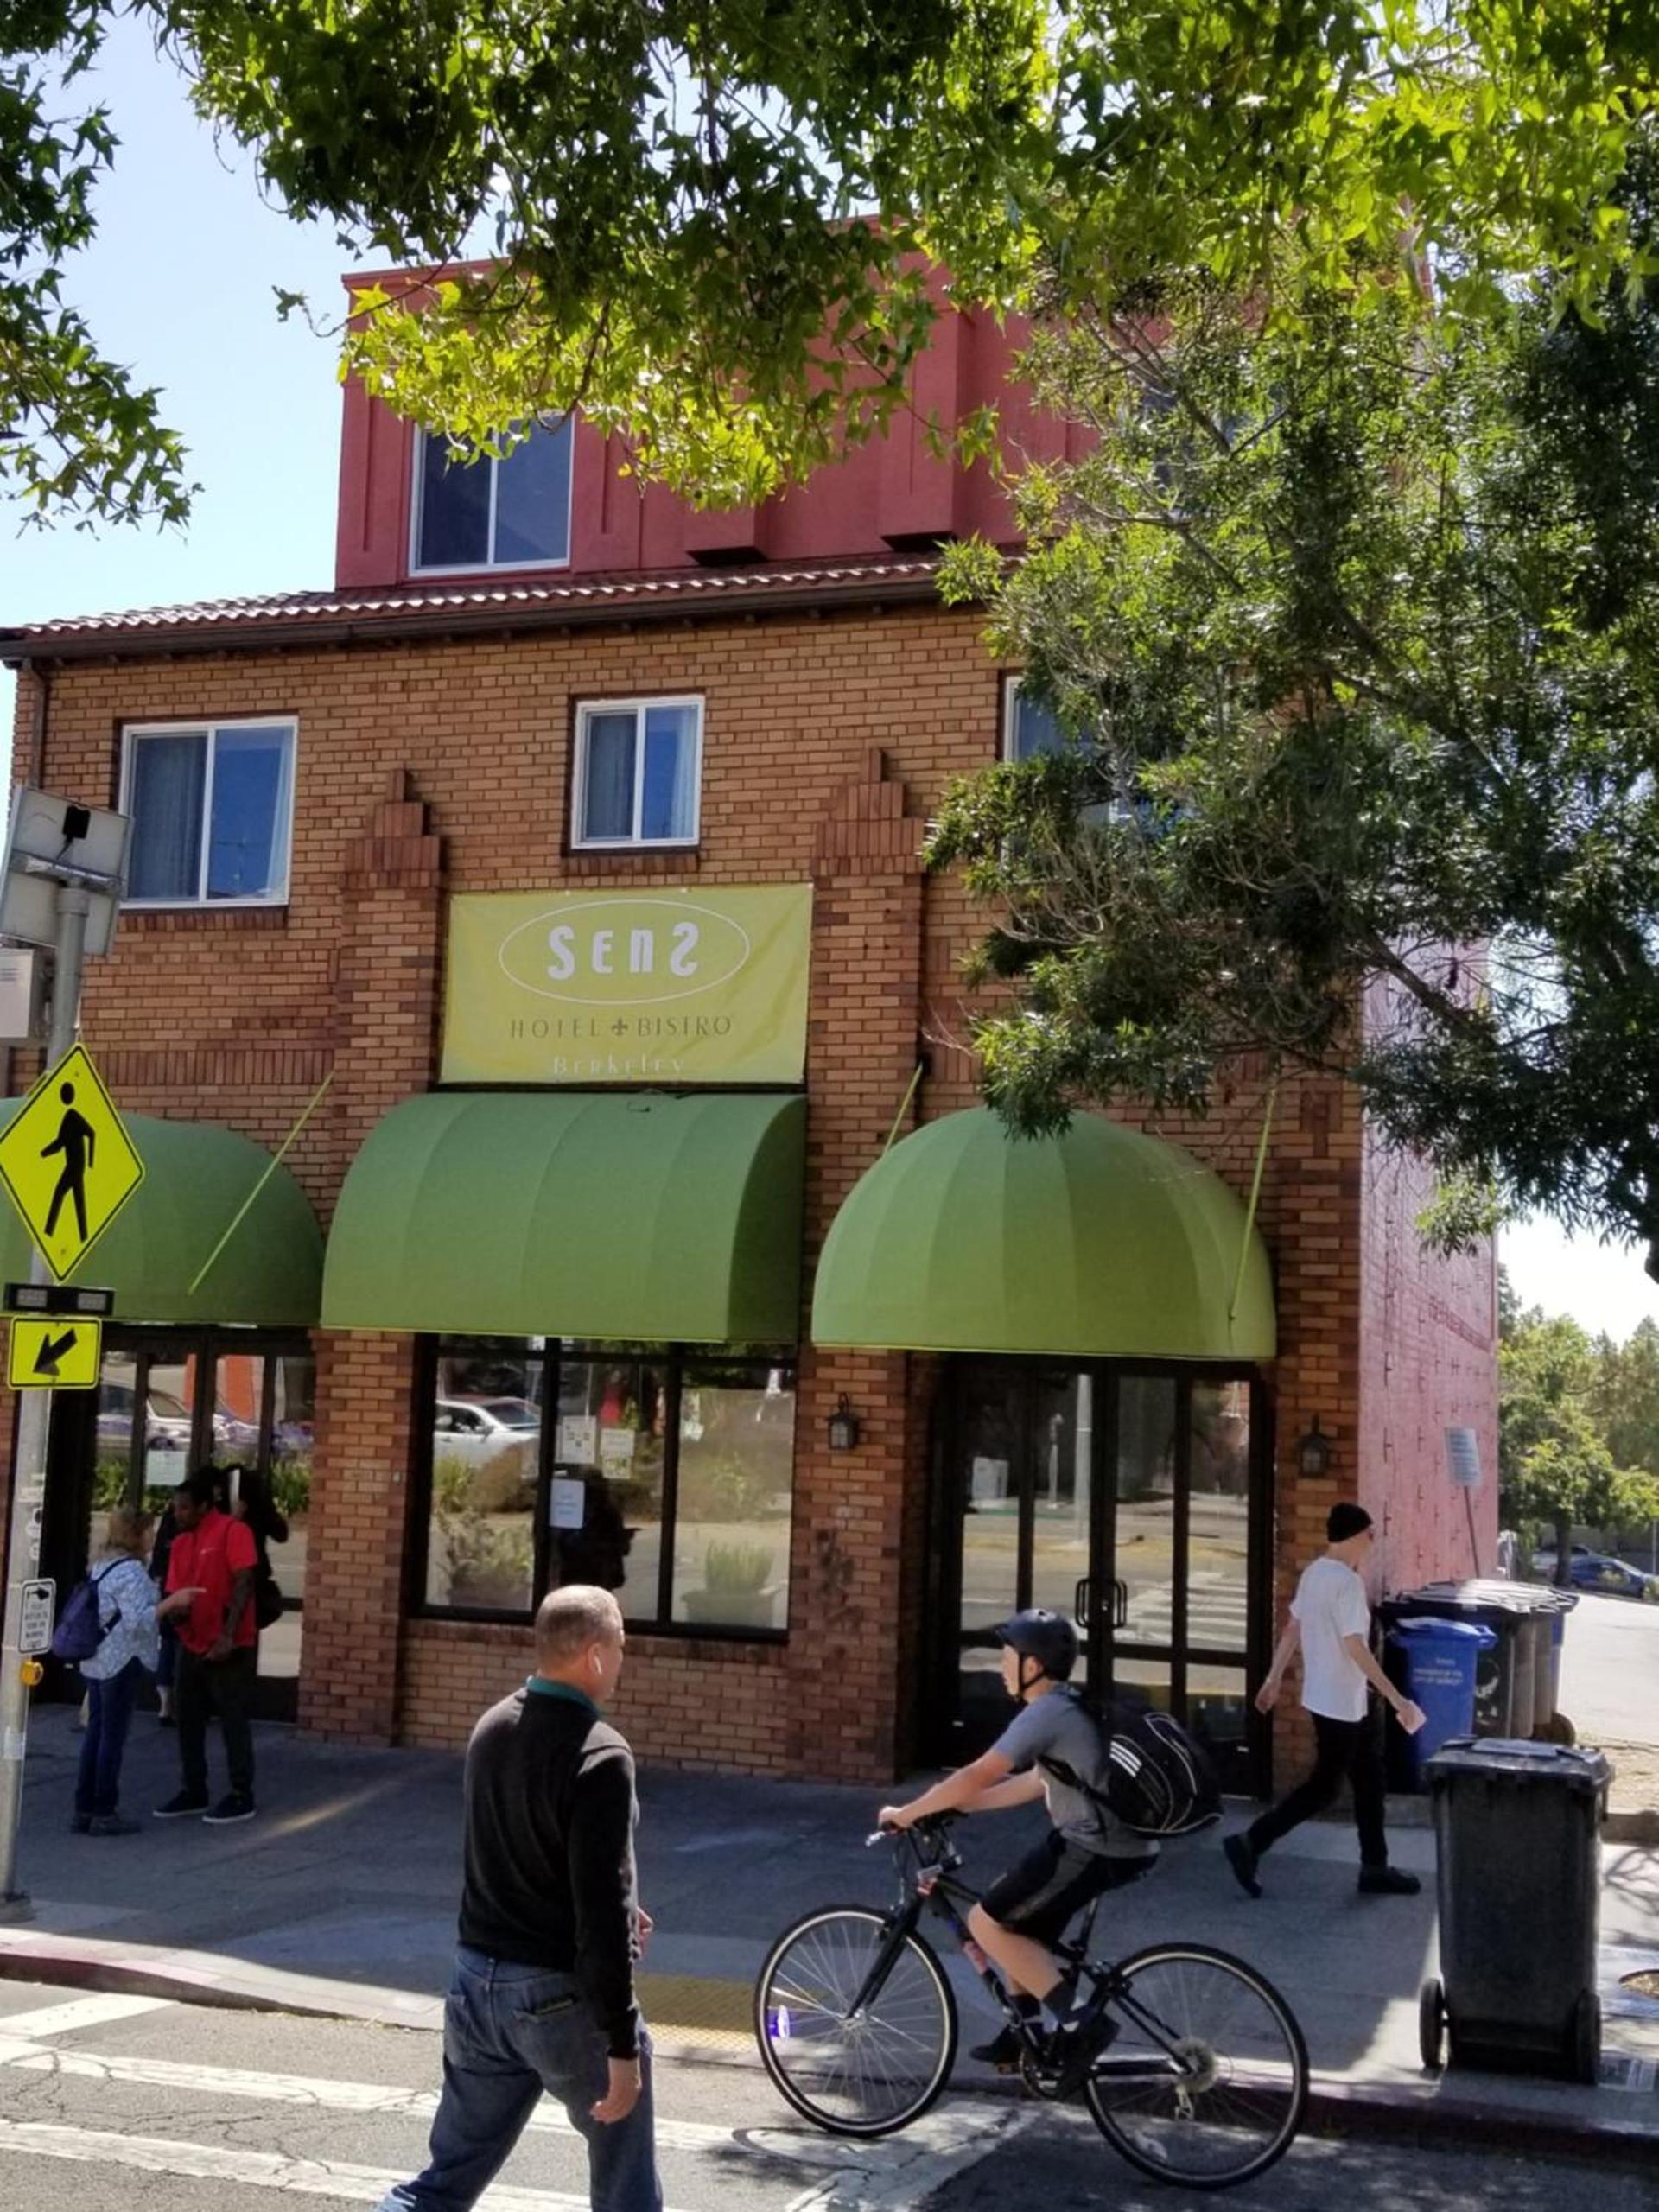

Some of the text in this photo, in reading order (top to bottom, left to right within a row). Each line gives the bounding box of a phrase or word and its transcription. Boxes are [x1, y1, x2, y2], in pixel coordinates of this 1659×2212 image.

[511, 1015, 732, 1039] HOTEL BISTRO
[553, 1052, 686, 1076] Berkeley
